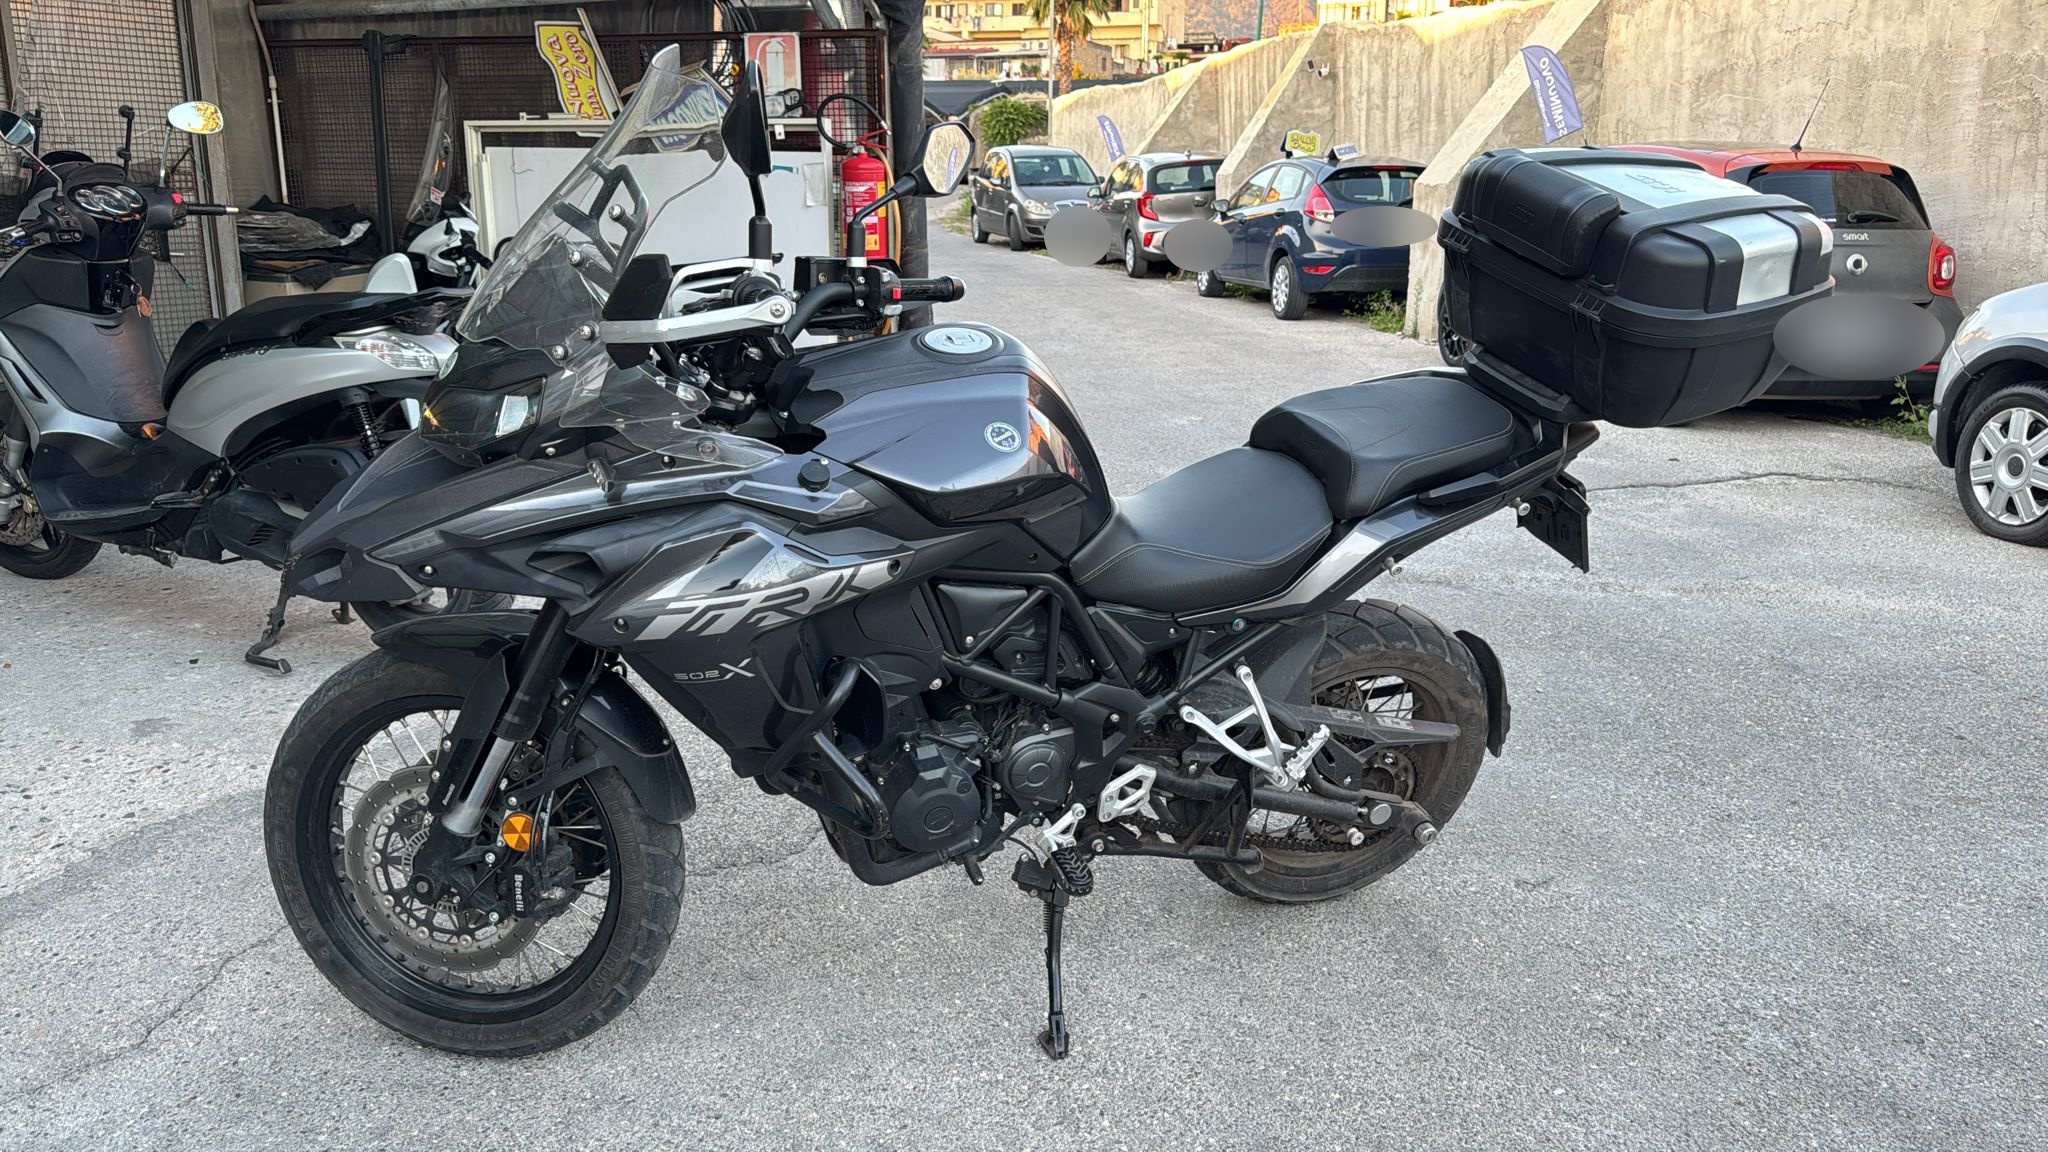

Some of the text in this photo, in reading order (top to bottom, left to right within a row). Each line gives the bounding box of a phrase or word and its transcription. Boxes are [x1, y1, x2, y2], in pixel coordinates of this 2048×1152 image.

[564, 31, 592, 80] Zero
[1842, 232, 1869, 241] smart
[655, 562, 877, 641] TRK
[514, 874, 524, 911] Benelli
